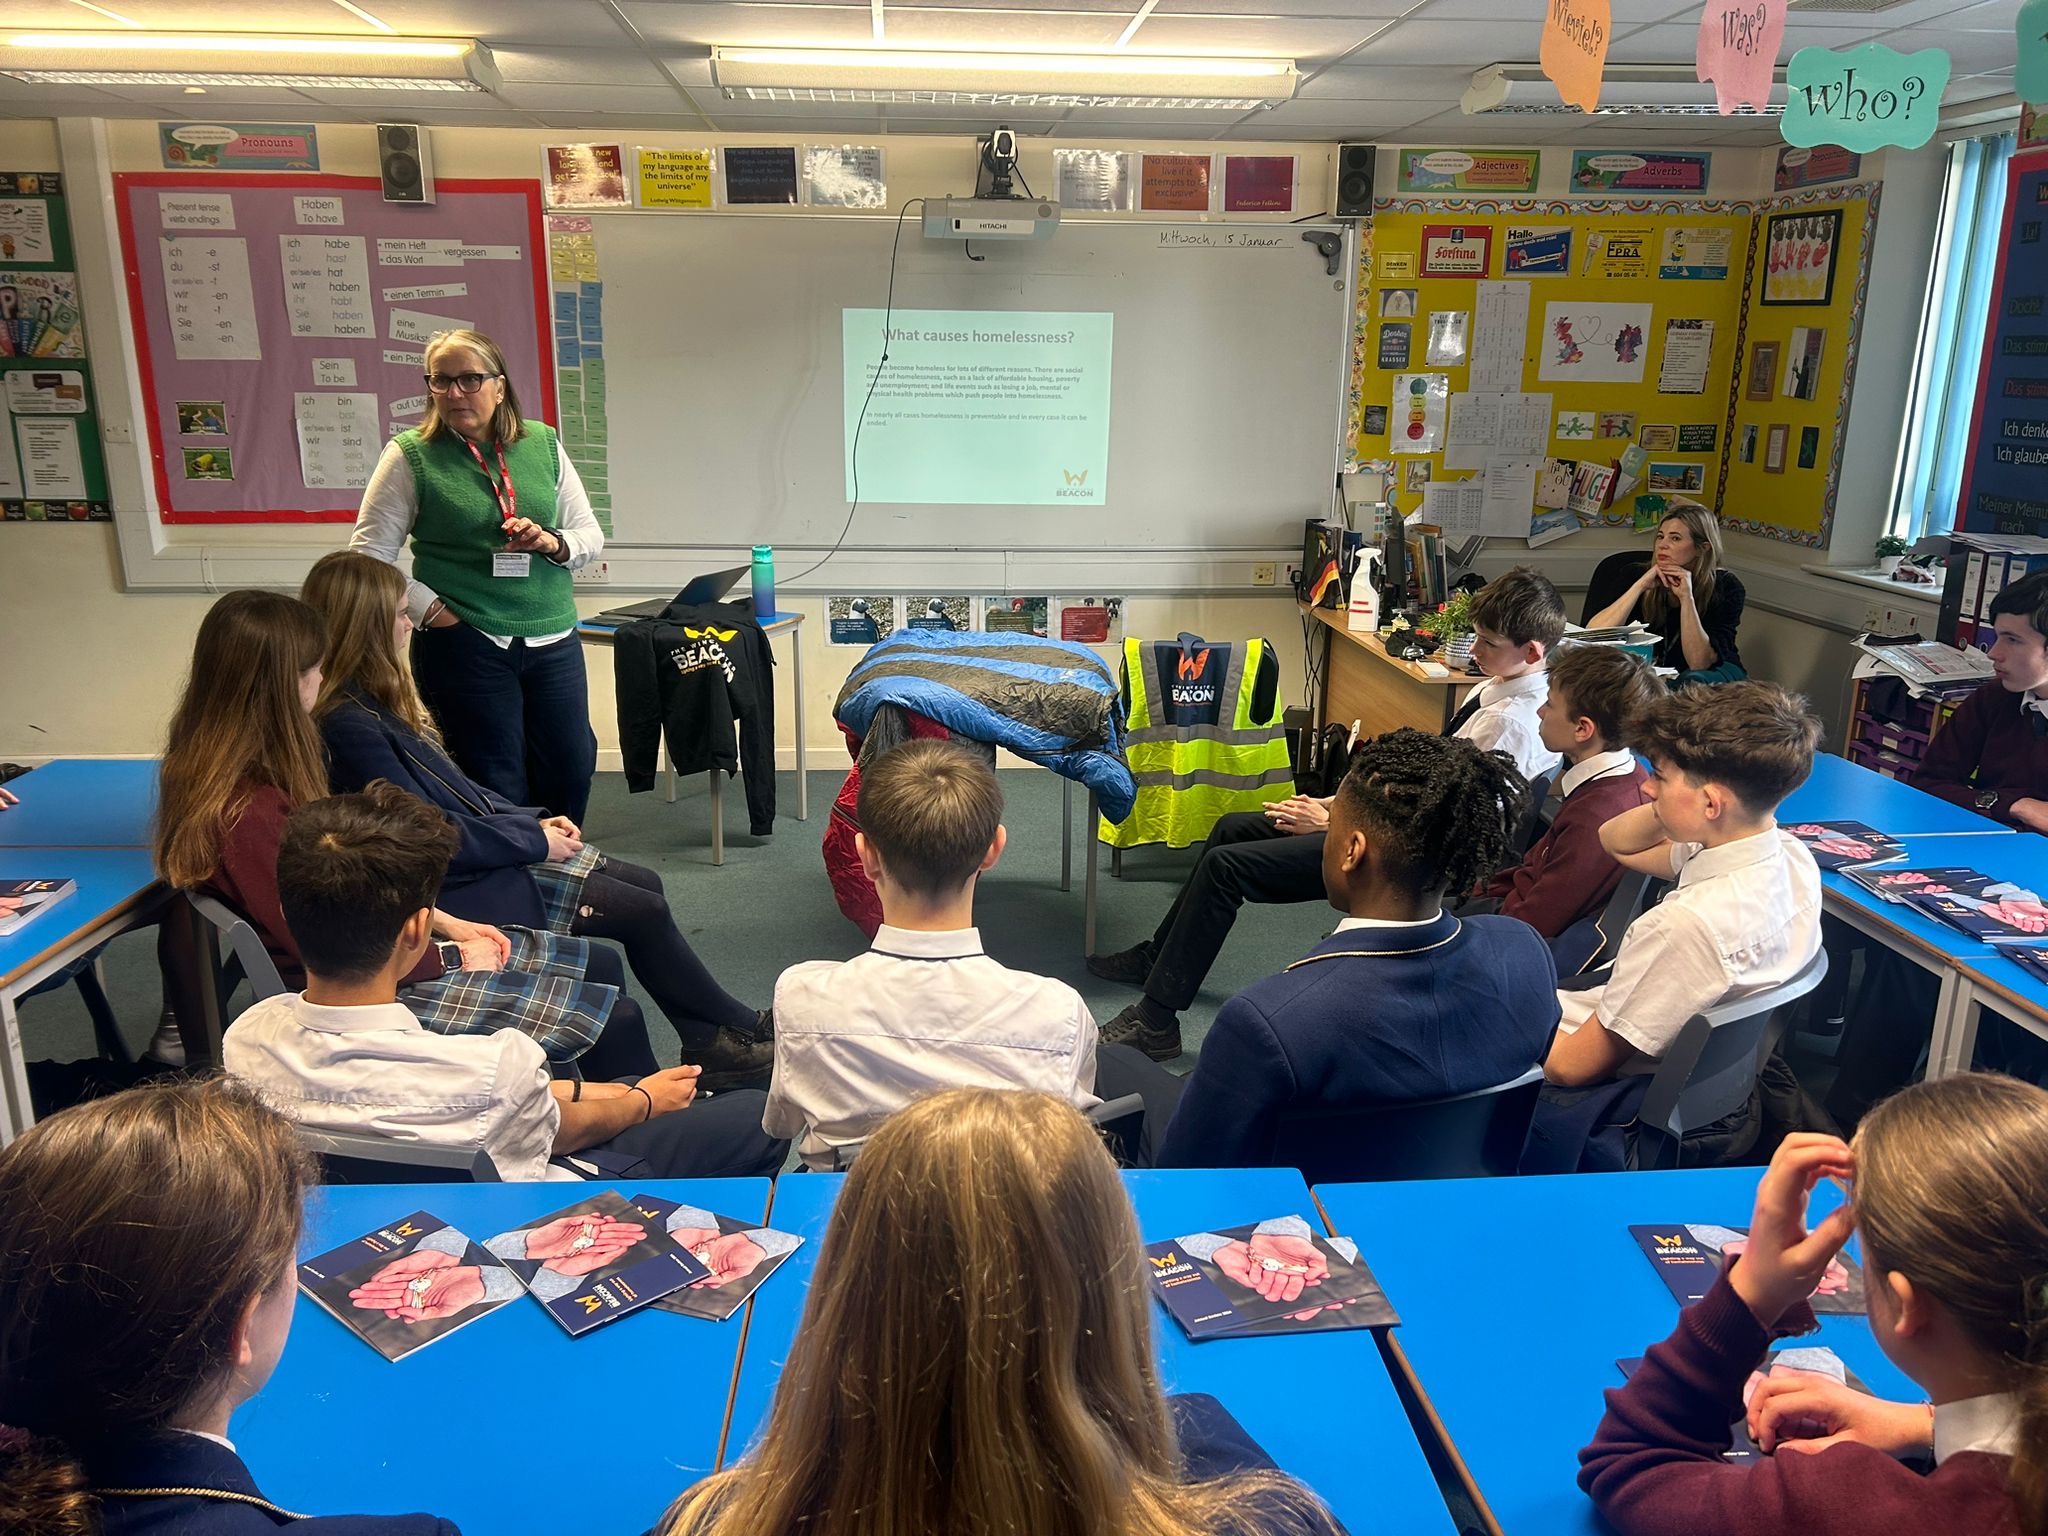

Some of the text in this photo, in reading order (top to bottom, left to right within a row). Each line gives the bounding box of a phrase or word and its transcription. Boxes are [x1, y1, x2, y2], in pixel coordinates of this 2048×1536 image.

[1721, 3, 1766, 56] Was?
[241, 138, 294, 147] Pronouns
[669, 152, 692, 161] limits
[694, 152, 703, 161] of
[1162, 157, 1192, 165] culture
[643, 164, 656, 173] my
[658, 163, 694, 172] language
[1162, 166, 1177, 175] live
[1475, 161, 1519, 172] Adjectives
[1643, 167, 1682, 176] Adverbs
[644, 172, 709, 182] the limits of my
[1146, 177, 1195, 188] attempts to
[167, 202, 220, 212] Present tense
[301, 200, 334, 209] Haben
[169, 214, 220, 225] verb endings
[303, 214, 337, 223] To have
[1160, 230, 1283, 247] Mittwoch, 15 Januar
[1508, 230, 1533, 240] Hallo
[287, 239, 350, 248] ich habe
[385, 241, 426, 250] mein Heft
[168, 247, 183, 257] ich
[444, 248, 487, 257] vergessen
[326, 254, 347, 262] hast
[385, 255, 424, 264] das Wort
[170, 262, 183, 271] du
[327, 268, 343, 277] hat
[329, 282, 360, 292] haben
[390, 288, 445, 300] einen Termin
[331, 296, 352, 306] habt
[176, 304, 187, 313] ihr
[332, 310, 363, 320] haben
[177, 318, 192, 327] Sie
[396, 319, 415, 329] eine
[298, 324, 365, 334] sie haben
[882, 328, 1074, 343] What causes homelessness?
[390, 353, 403, 361] ein
[320, 361, 339, 370] Sein
[916, 364, 946, 372] homeless
[321, 374, 344, 383] To be
[897, 373, 942, 381] homelessness,
[1028, 375, 1054, 383] housing,
[302, 396, 352, 405] ich bin
[970, 413, 1006, 421] preventable
[340, 424, 351, 432] ist
[2004, 421, 2018, 436] Ich
[306, 436, 361, 446] wir sind
[1997, 446, 2012, 461] Ich
[311, 477, 366, 486] sie sind
[1570, 466, 1612, 502] HUGE
[1979, 495, 2013, 513] Meiner
[2000, 520, 2025, 534] nach
[592, 1283, 621, 1308] BEACON
